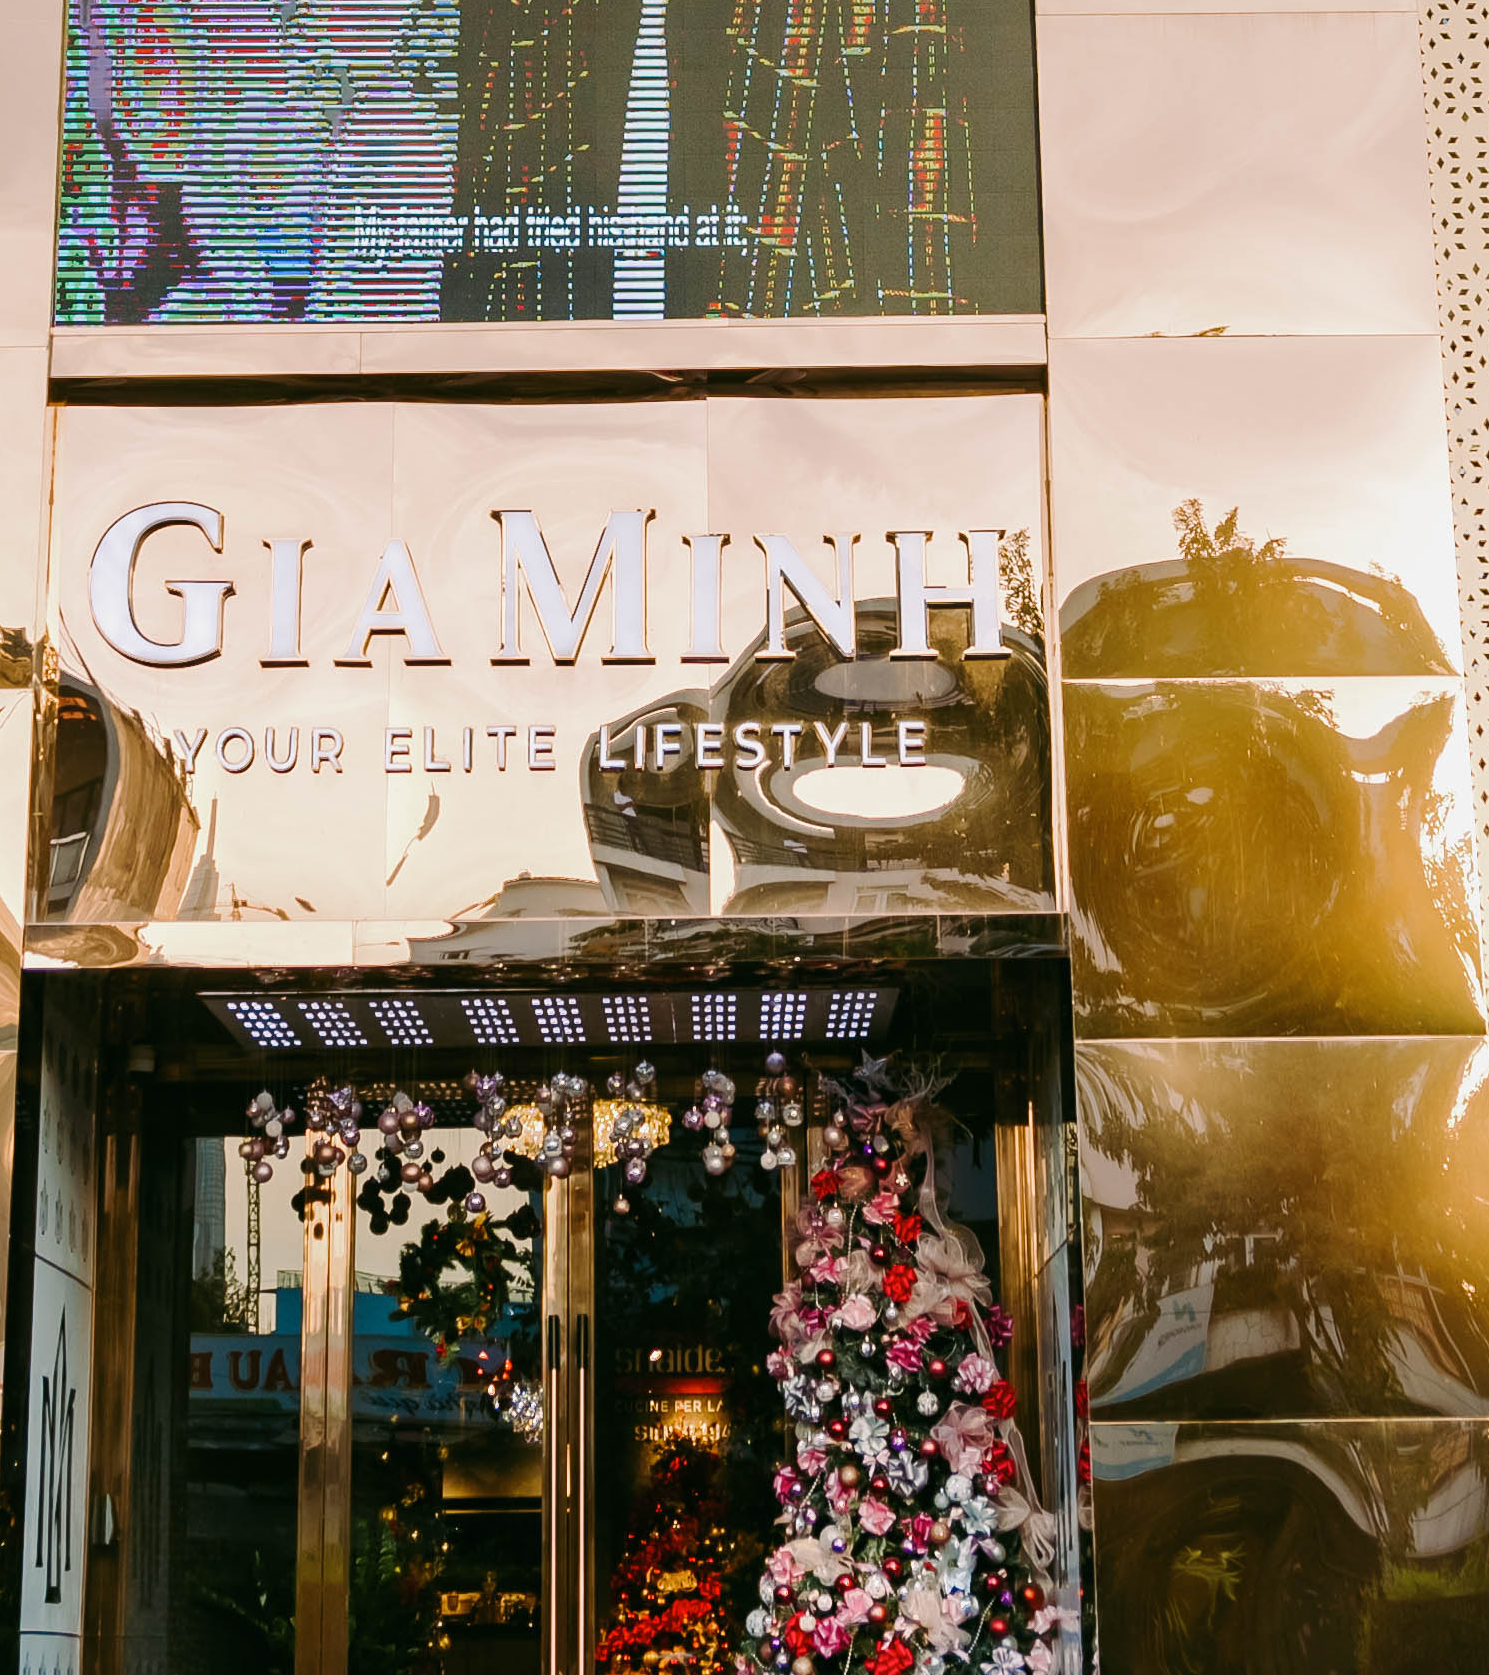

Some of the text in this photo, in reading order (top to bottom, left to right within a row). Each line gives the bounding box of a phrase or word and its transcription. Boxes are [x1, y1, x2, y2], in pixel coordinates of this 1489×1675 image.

[474, 204, 520, 252] had
[525, 204, 581, 252] tried
[695, 204, 720, 250] at
[88, 498, 1015, 669] GIA MINH
[173, 719, 927, 775] YOUR ELITE LIFESTYLE
